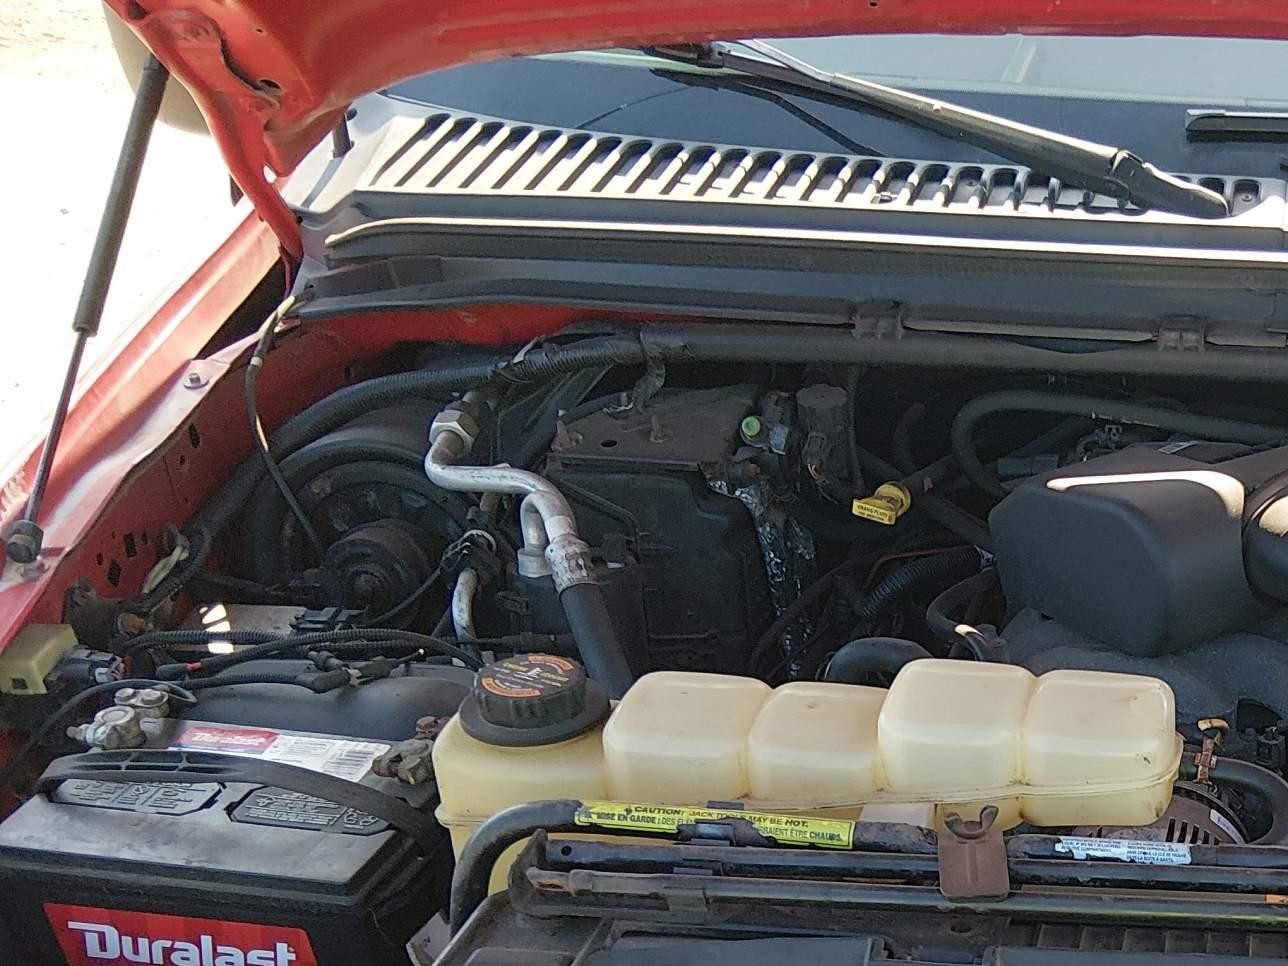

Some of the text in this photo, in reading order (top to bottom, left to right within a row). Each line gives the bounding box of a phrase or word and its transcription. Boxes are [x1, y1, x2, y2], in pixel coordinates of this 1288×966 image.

[618, 814, 629, 822] EN
[630, 815, 656, 824] GARDE
[661, 817, 675, 826] DES
[785, 819, 809, 828] HOT.
